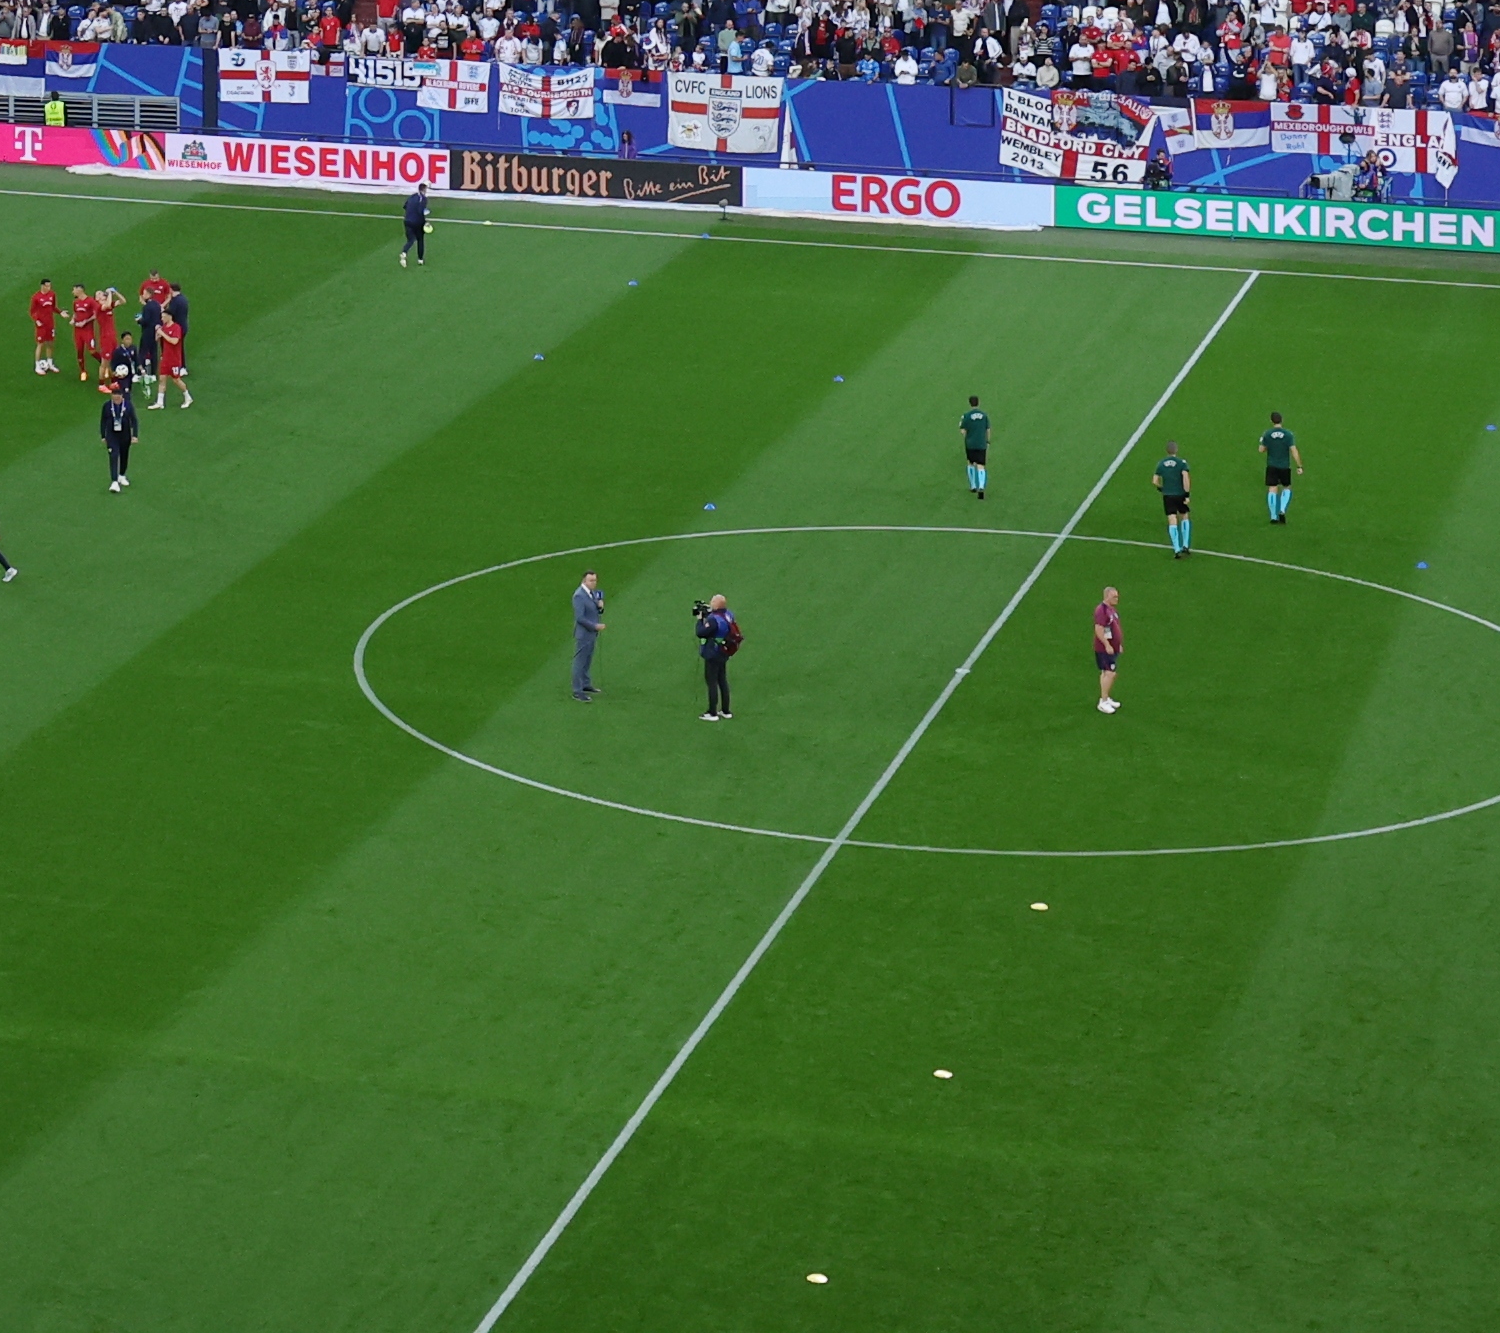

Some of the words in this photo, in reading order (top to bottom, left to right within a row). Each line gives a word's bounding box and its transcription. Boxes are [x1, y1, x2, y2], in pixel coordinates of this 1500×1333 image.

[675, 79, 706, 94] CVFC
[745, 84, 778, 99] LIONS
[1006, 122, 1097, 156] BRADFORD
[1274, 123, 1345, 134] MEXBOROUGH
[1346, 126, 1373, 135] OWLS
[224, 142, 447, 184] WIESENHOF
[1001, 136, 1062, 163] WEMBLEY
[1011, 152, 1045, 171] 2013
[167, 159, 223, 171] WIESENHOF
[461, 152, 612, 197] Bitburger
[1090, 162, 1129, 185] 56
[623, 178, 661, 200] Bitte
[667, 178, 694, 192] ein
[697, 165, 731, 185] Bit
[831, 175, 961, 218] ERGO
[1077, 192, 1495, 247] GELSENKIRCHEN
